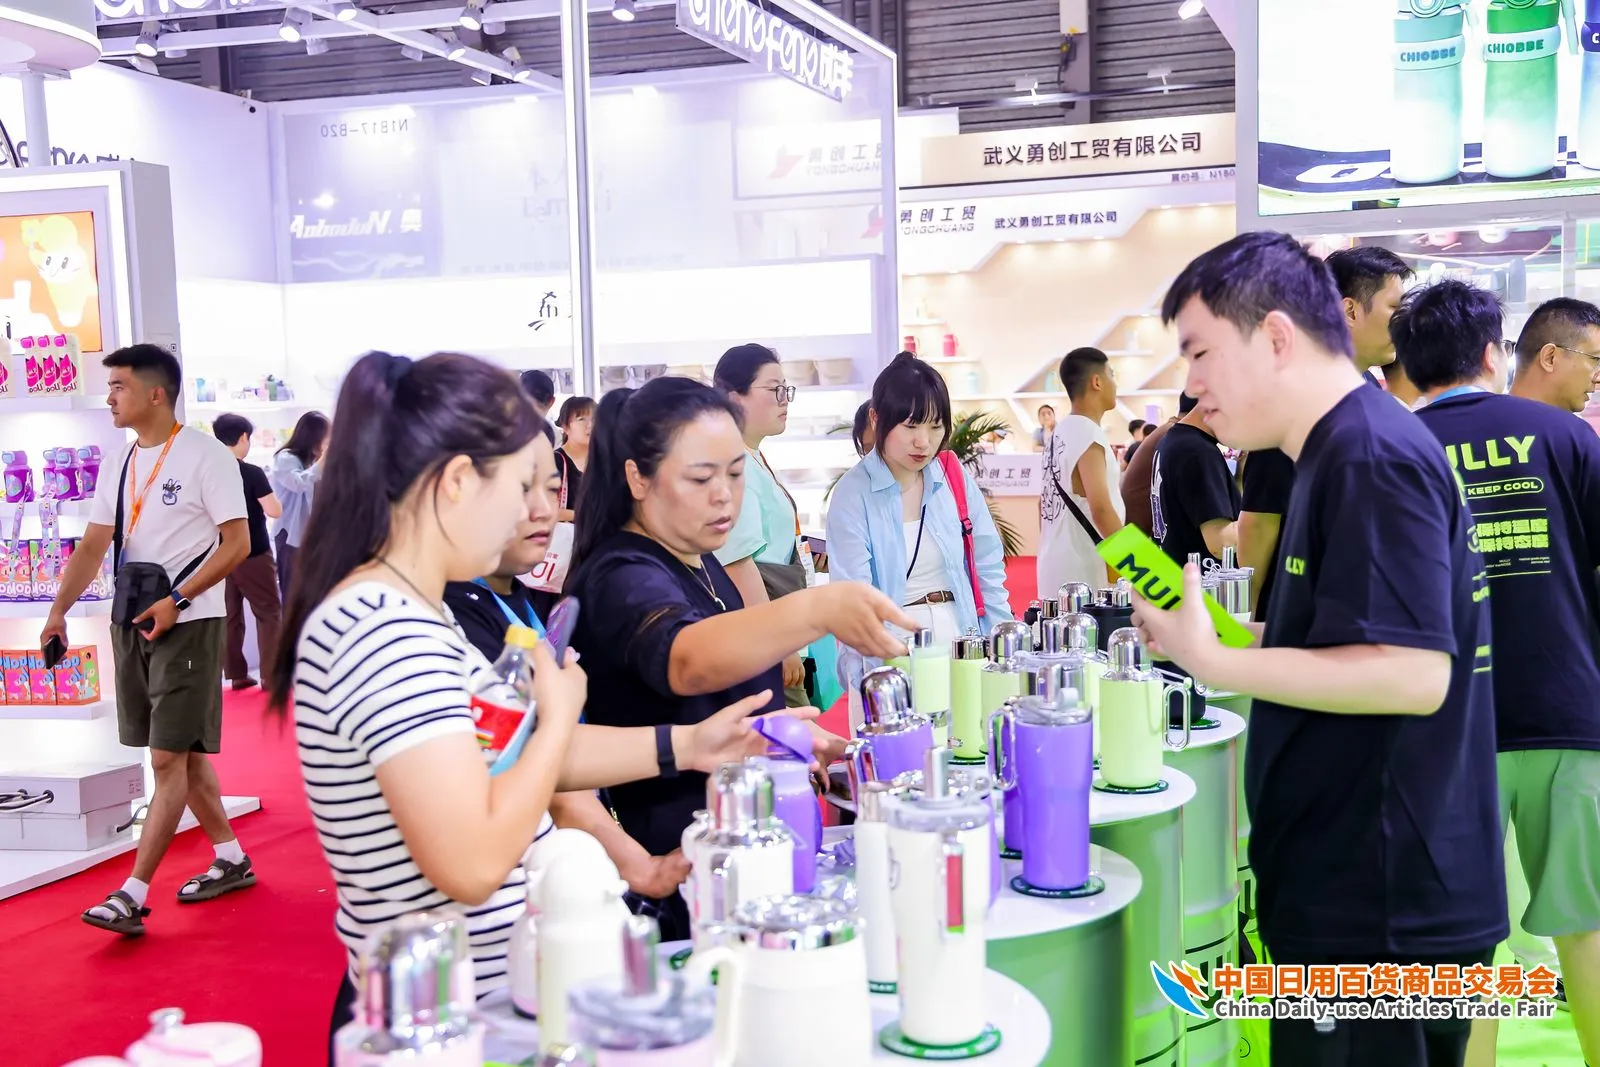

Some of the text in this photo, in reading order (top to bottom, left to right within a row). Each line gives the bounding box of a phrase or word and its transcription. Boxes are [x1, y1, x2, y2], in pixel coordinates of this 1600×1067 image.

[983, 132, 1201, 166] 武义勇创工贸有限公司
[806, 161, 880, 177] YONGCHUAN
[900, 205, 976, 224] 勇创工贸
[994, 210, 1118, 230] 武义勇创工贸有限公司
[901, 222, 976, 236] ONGCHUANG
[1467, 480, 1538, 496] KEEP COOL
